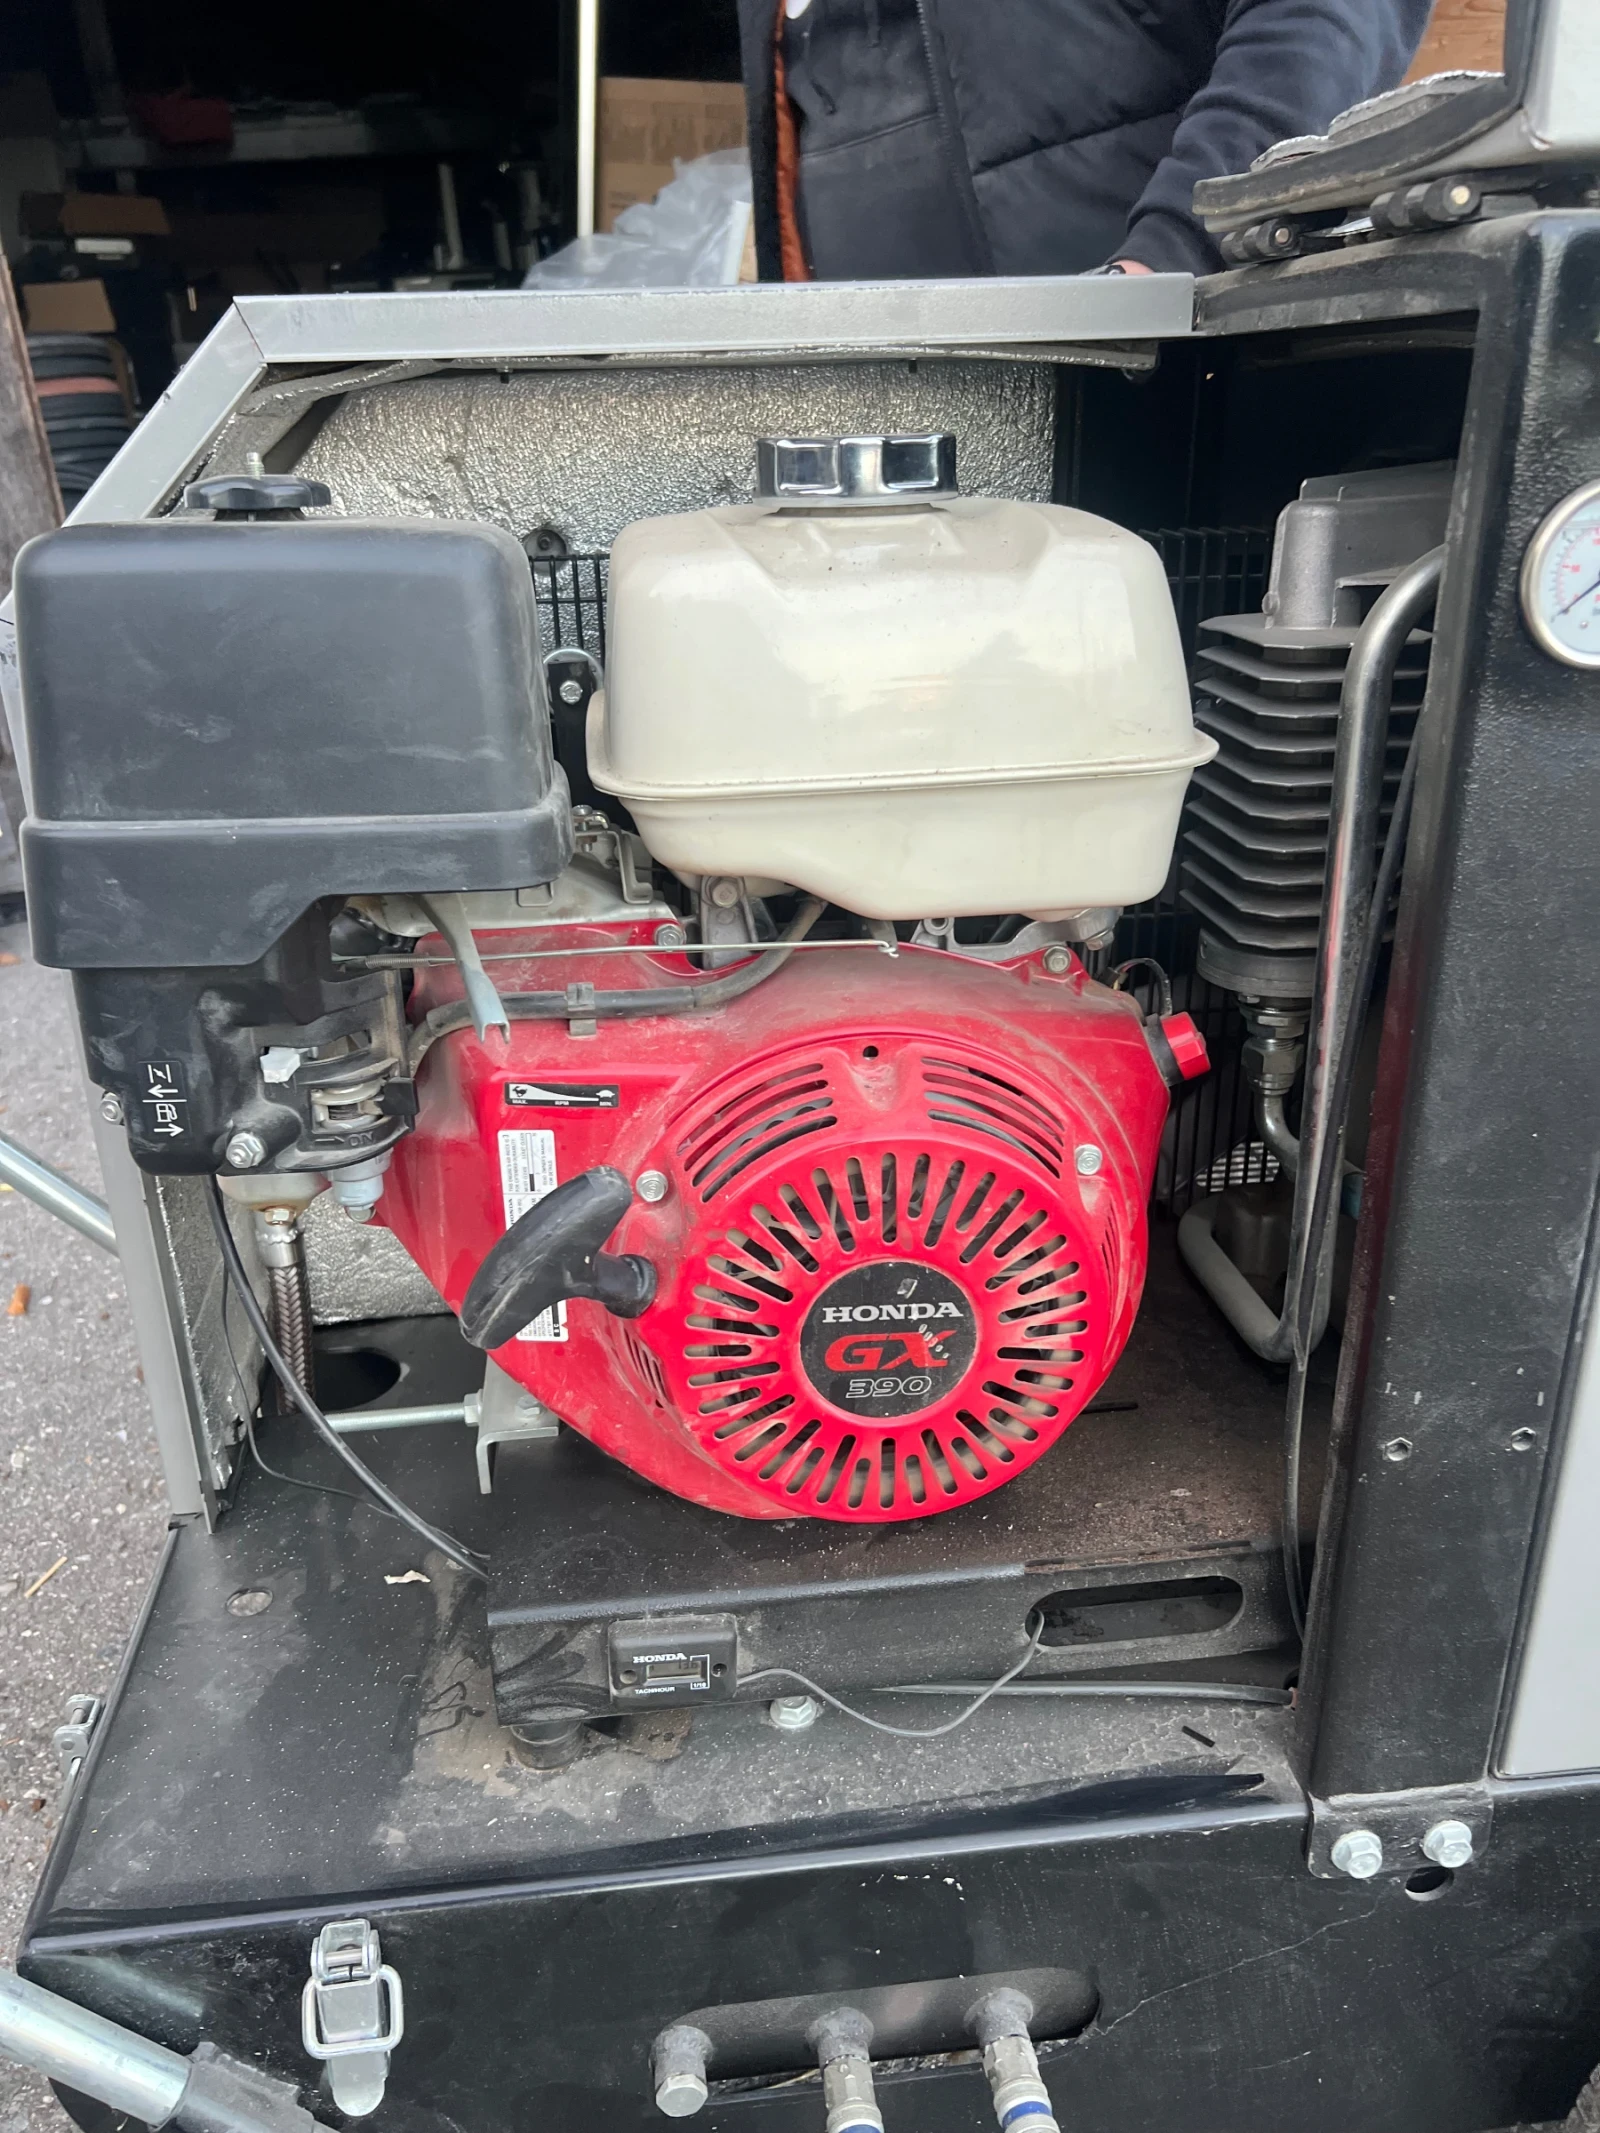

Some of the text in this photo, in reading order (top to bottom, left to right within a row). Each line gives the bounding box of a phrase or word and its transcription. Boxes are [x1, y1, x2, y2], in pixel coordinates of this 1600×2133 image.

[348, 1131, 374, 1147] ON
[822, 1302, 963, 1323] HONDA
[824, 1329, 958, 1372] GX
[845, 1375, 932, 1399] 390
[632, 1652, 688, 1664] HONDA
